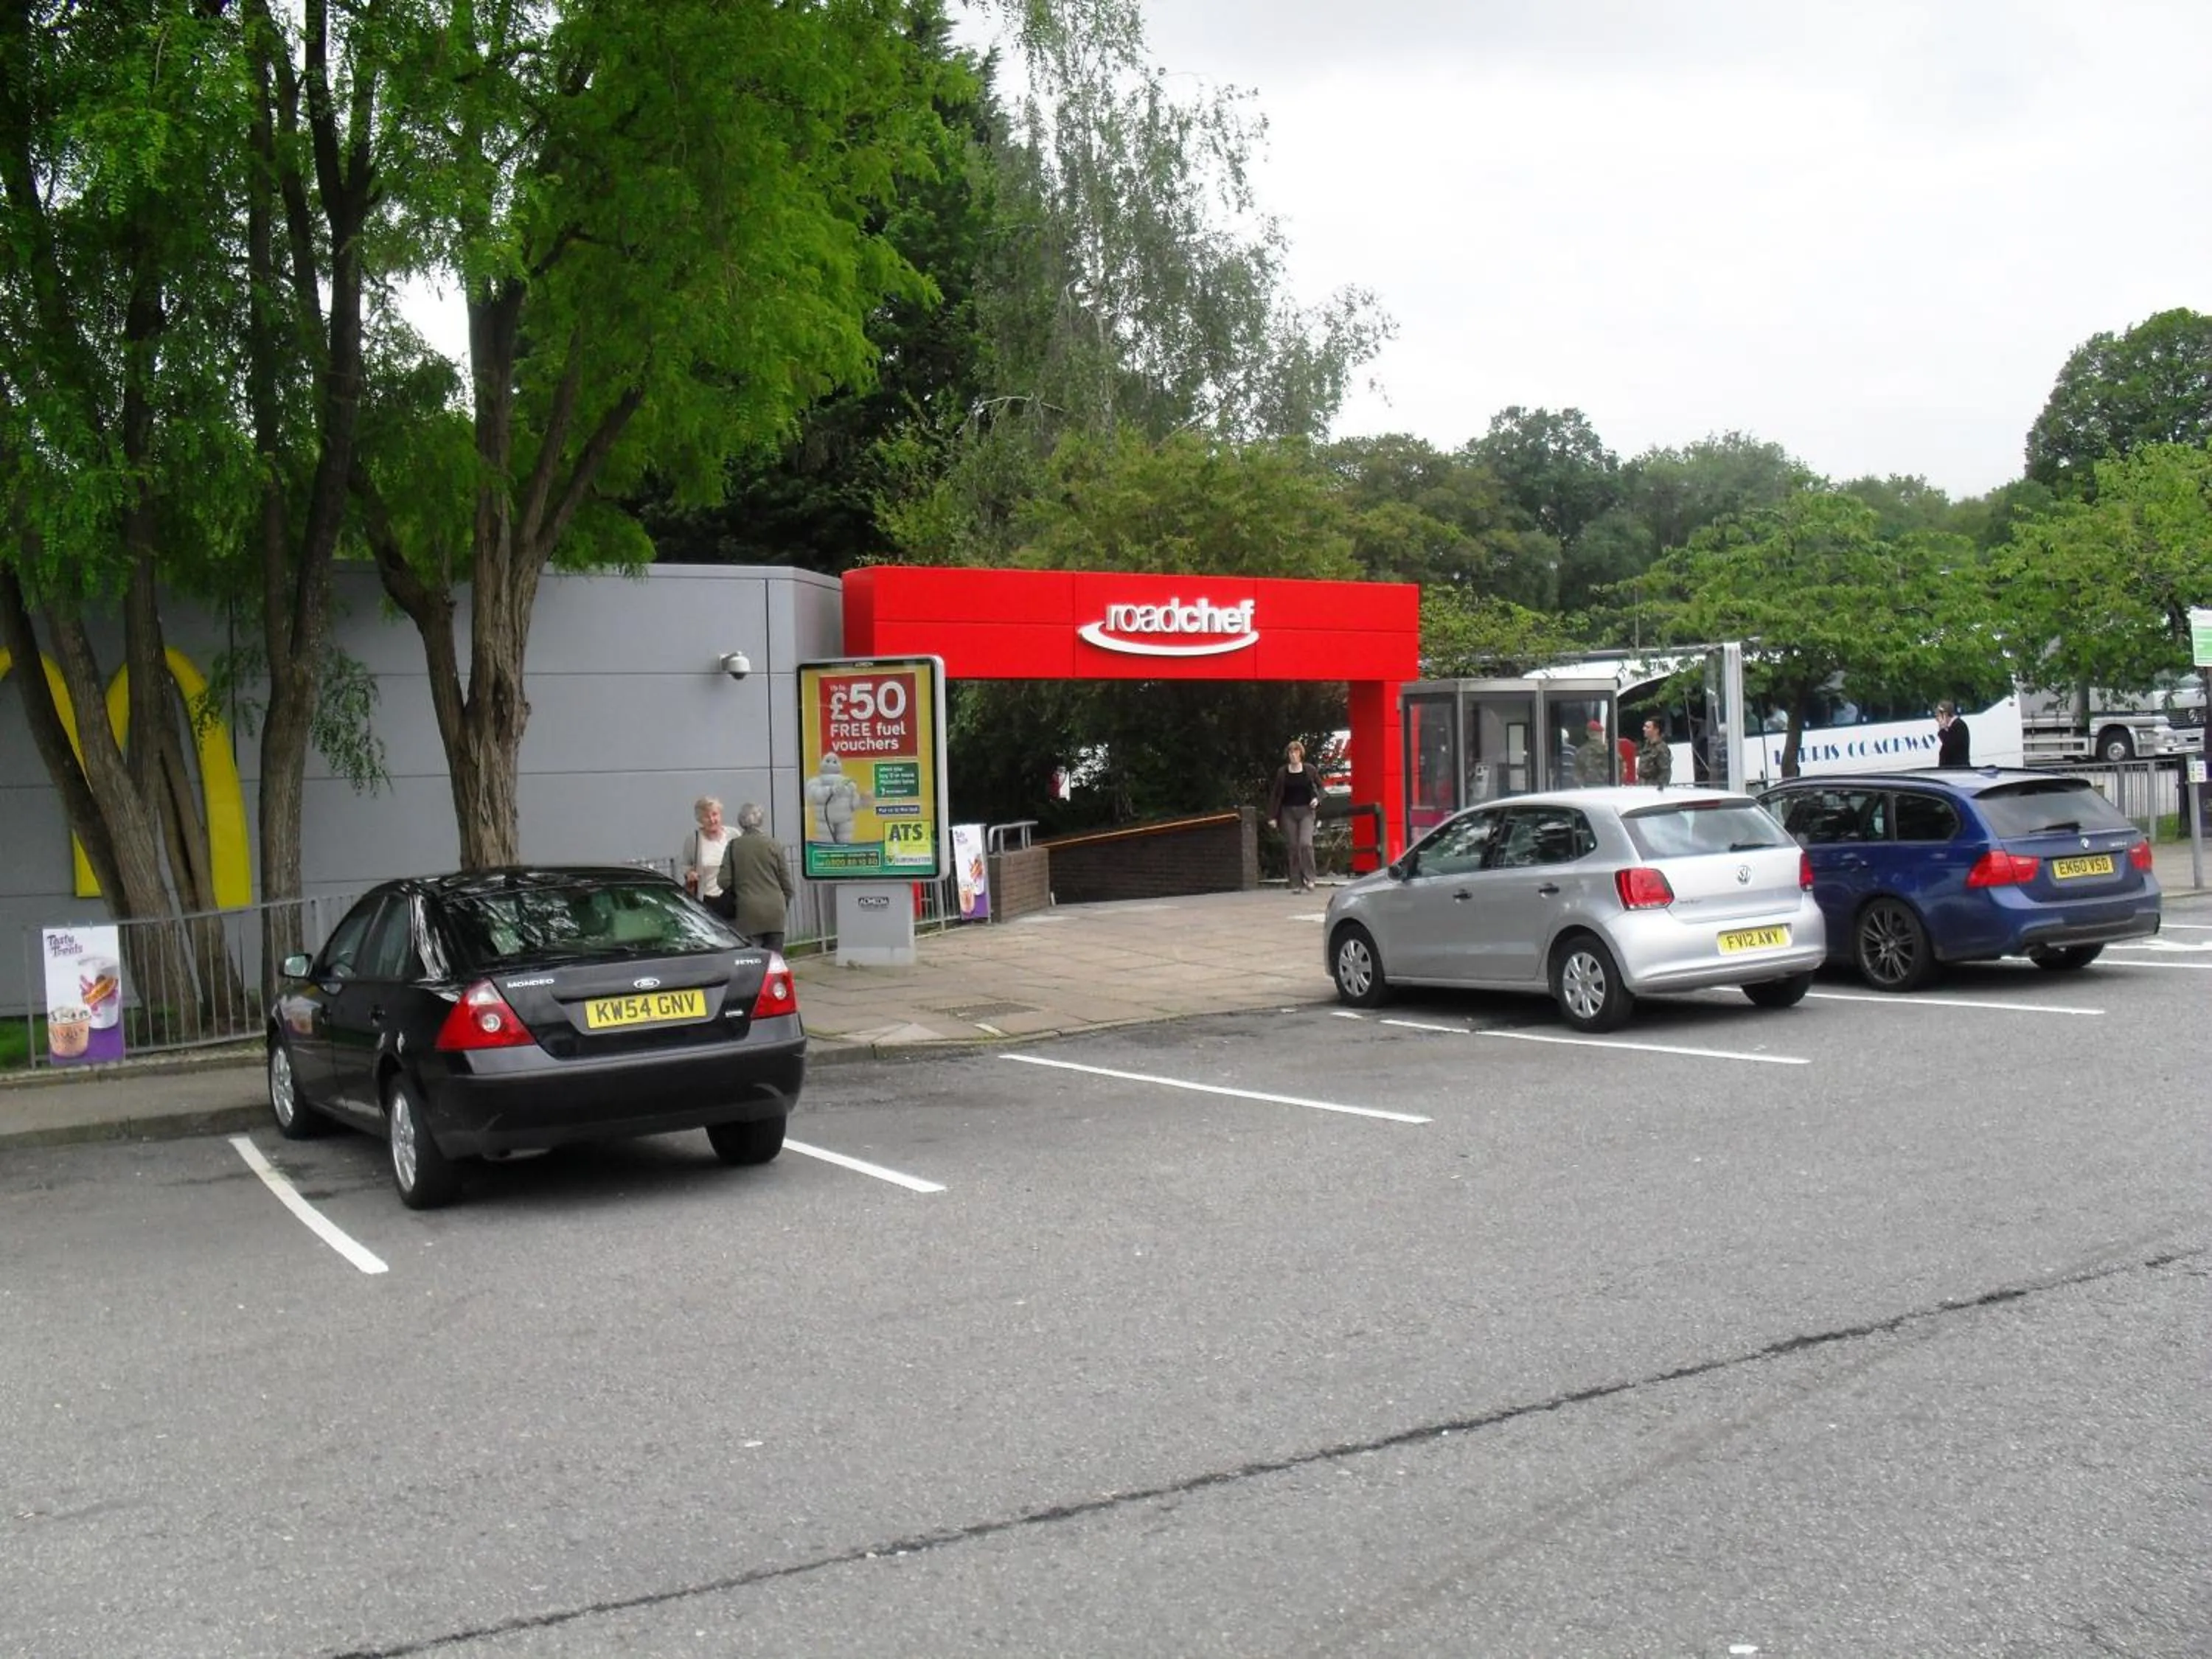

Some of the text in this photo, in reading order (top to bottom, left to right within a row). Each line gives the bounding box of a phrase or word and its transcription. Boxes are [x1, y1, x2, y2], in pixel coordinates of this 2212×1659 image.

[1107, 597, 1255, 633] roadchef
[831, 681, 906, 721] £50
[830, 720, 905, 737] FREE fuel
[832, 737, 900, 752] vouchers
[888, 824, 922, 842] ATS
[2059, 860, 2087, 875] EK60
[47, 934, 75, 947] Tasty
[1726, 930, 1780, 949] FV12 AWY
[507, 978, 555, 989] MONDEO
[596, 992, 696, 1023] KW54 GNV
